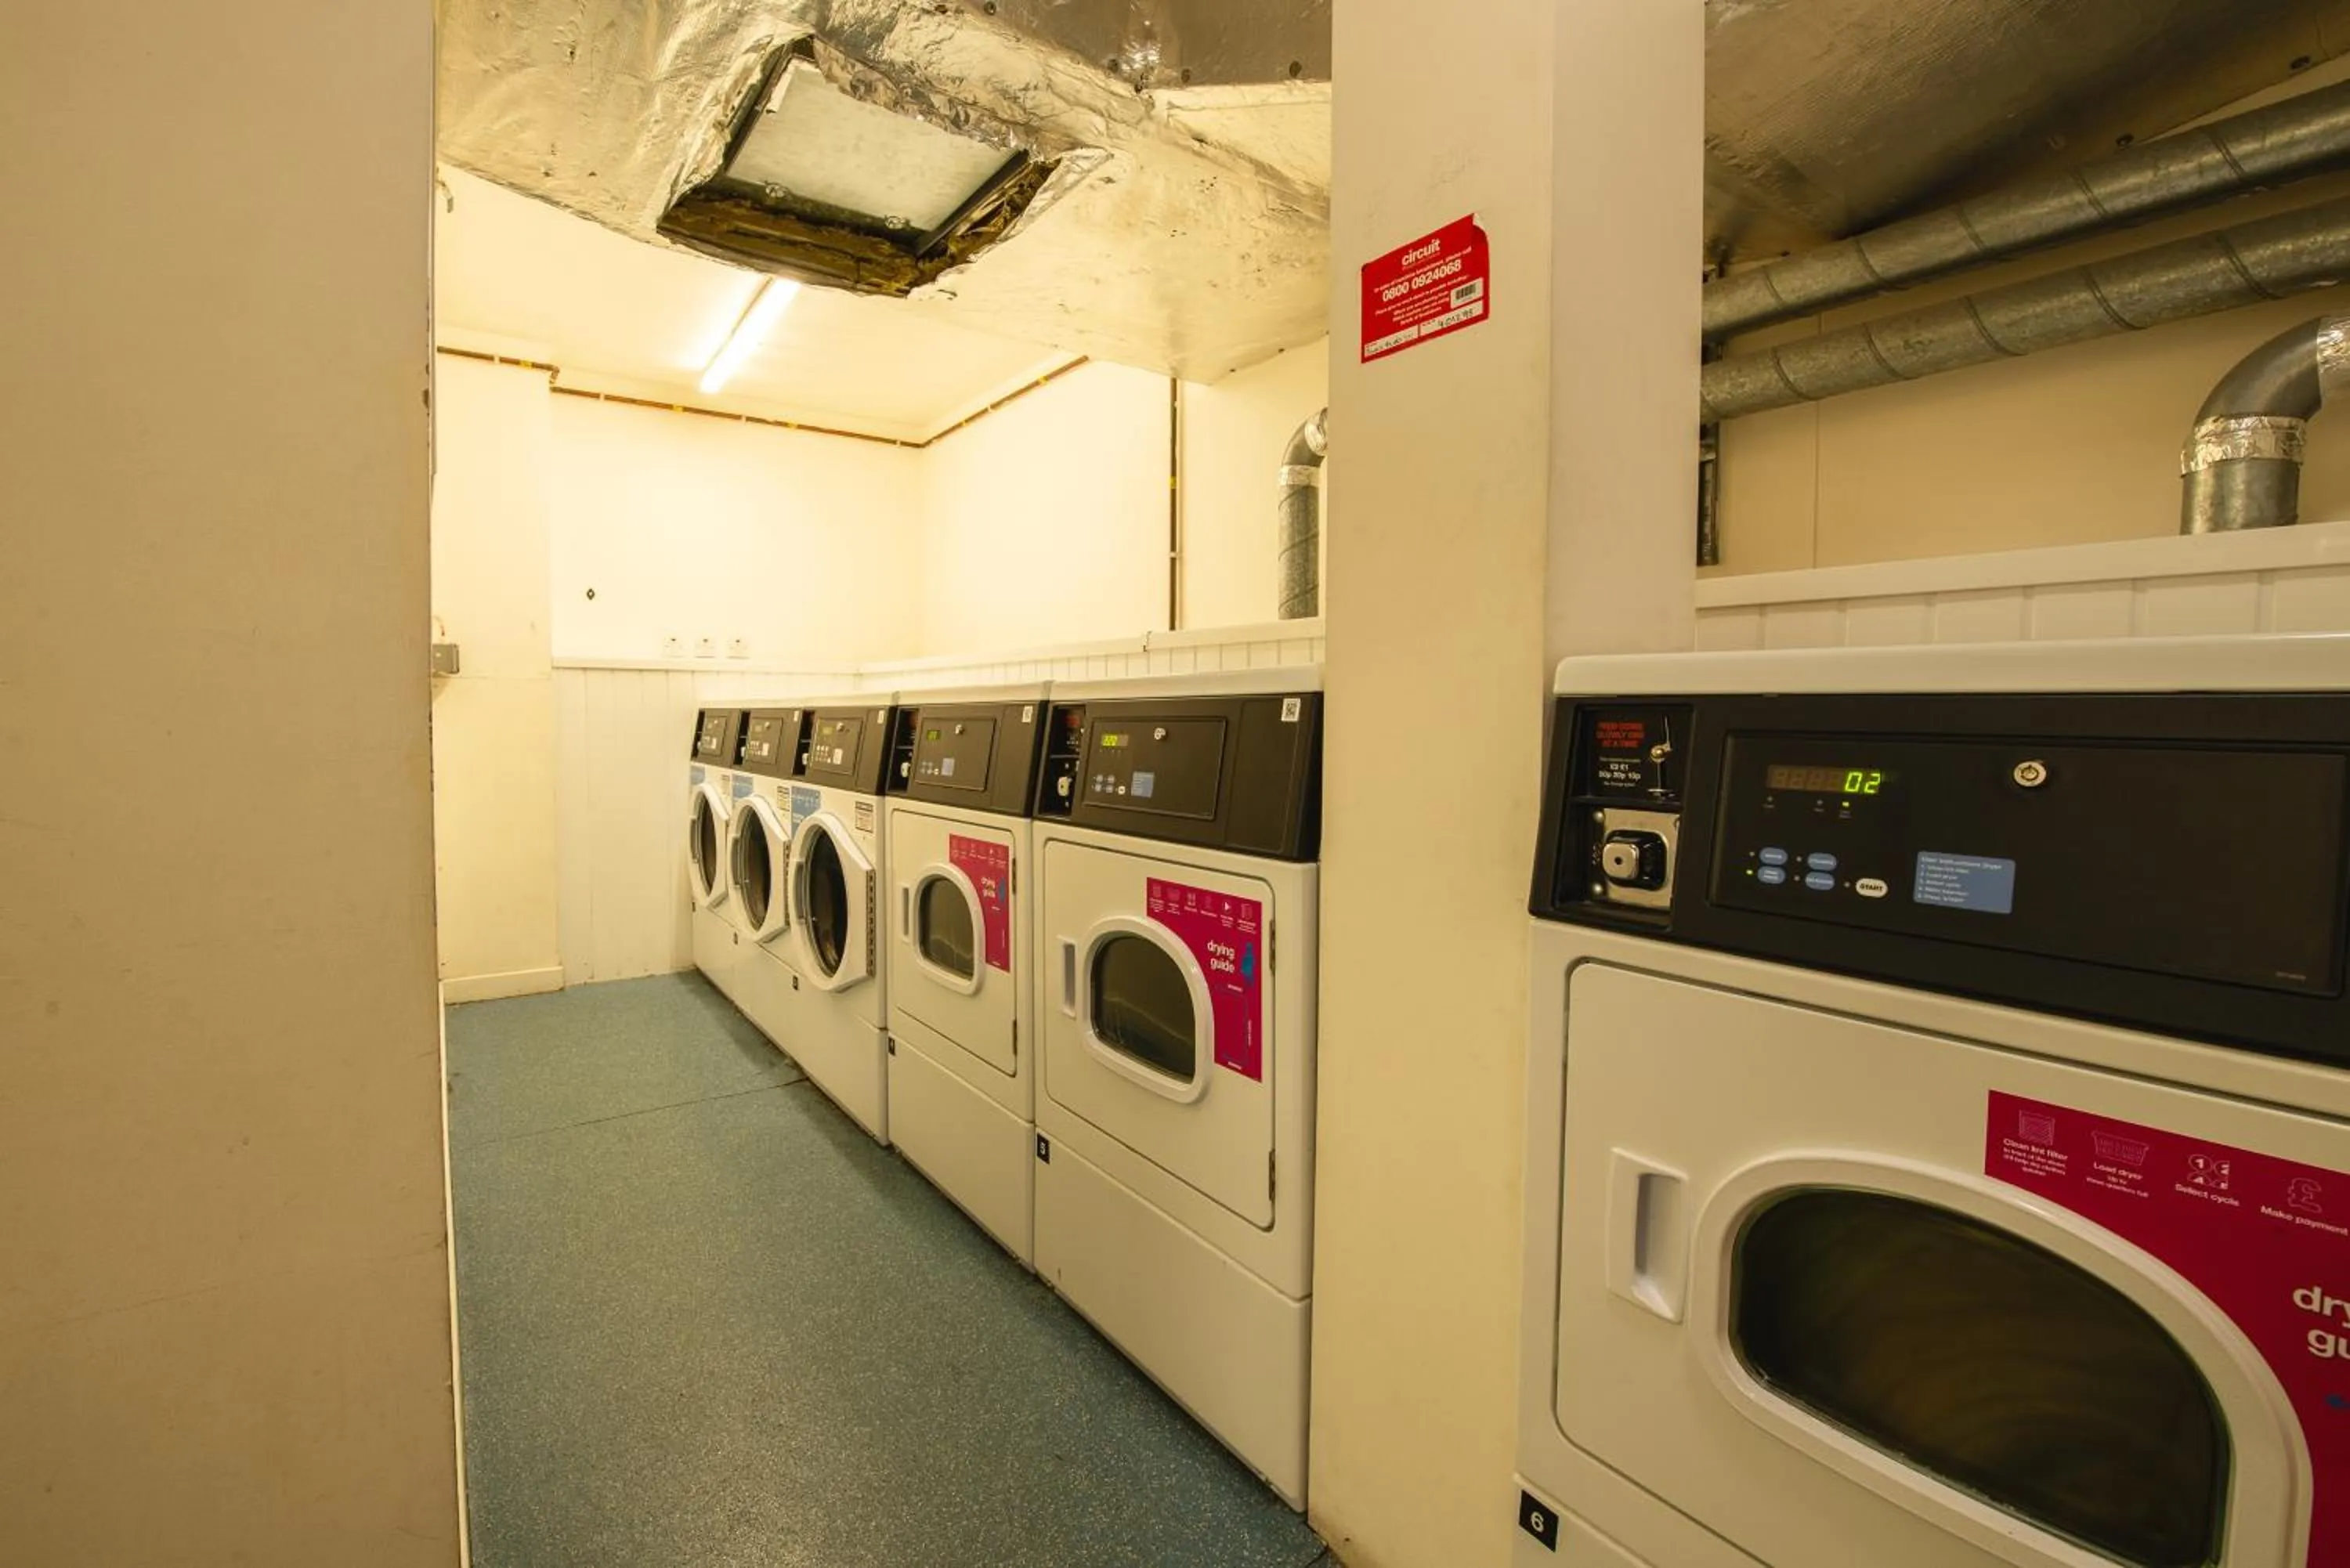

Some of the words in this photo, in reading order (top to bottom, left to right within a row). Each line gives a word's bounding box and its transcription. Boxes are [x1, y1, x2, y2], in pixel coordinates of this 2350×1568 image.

[1401, 238, 1441, 266] circuit
[1382, 281, 1410, 302] 0800
[1411, 259, 1462, 290] 0924068
[1845, 771, 1881, 793] 02
[1207, 939, 1235, 960] drying
[1210, 958, 1235, 974] guide
[2003, 1138, 2030, 1151] Clean
[2047, 1149, 2068, 1160] filter
[2093, 1161, 2117, 1174] Load
[2117, 1169, 2143, 1180] dryer
[2175, 1183, 2208, 1199] Select
[2210, 1193, 2240, 1207] cycle
[2260, 1205, 2294, 1221] Make
[2295, 1216, 2348, 1236] payment
[1531, 1511, 1544, 1533] 6
